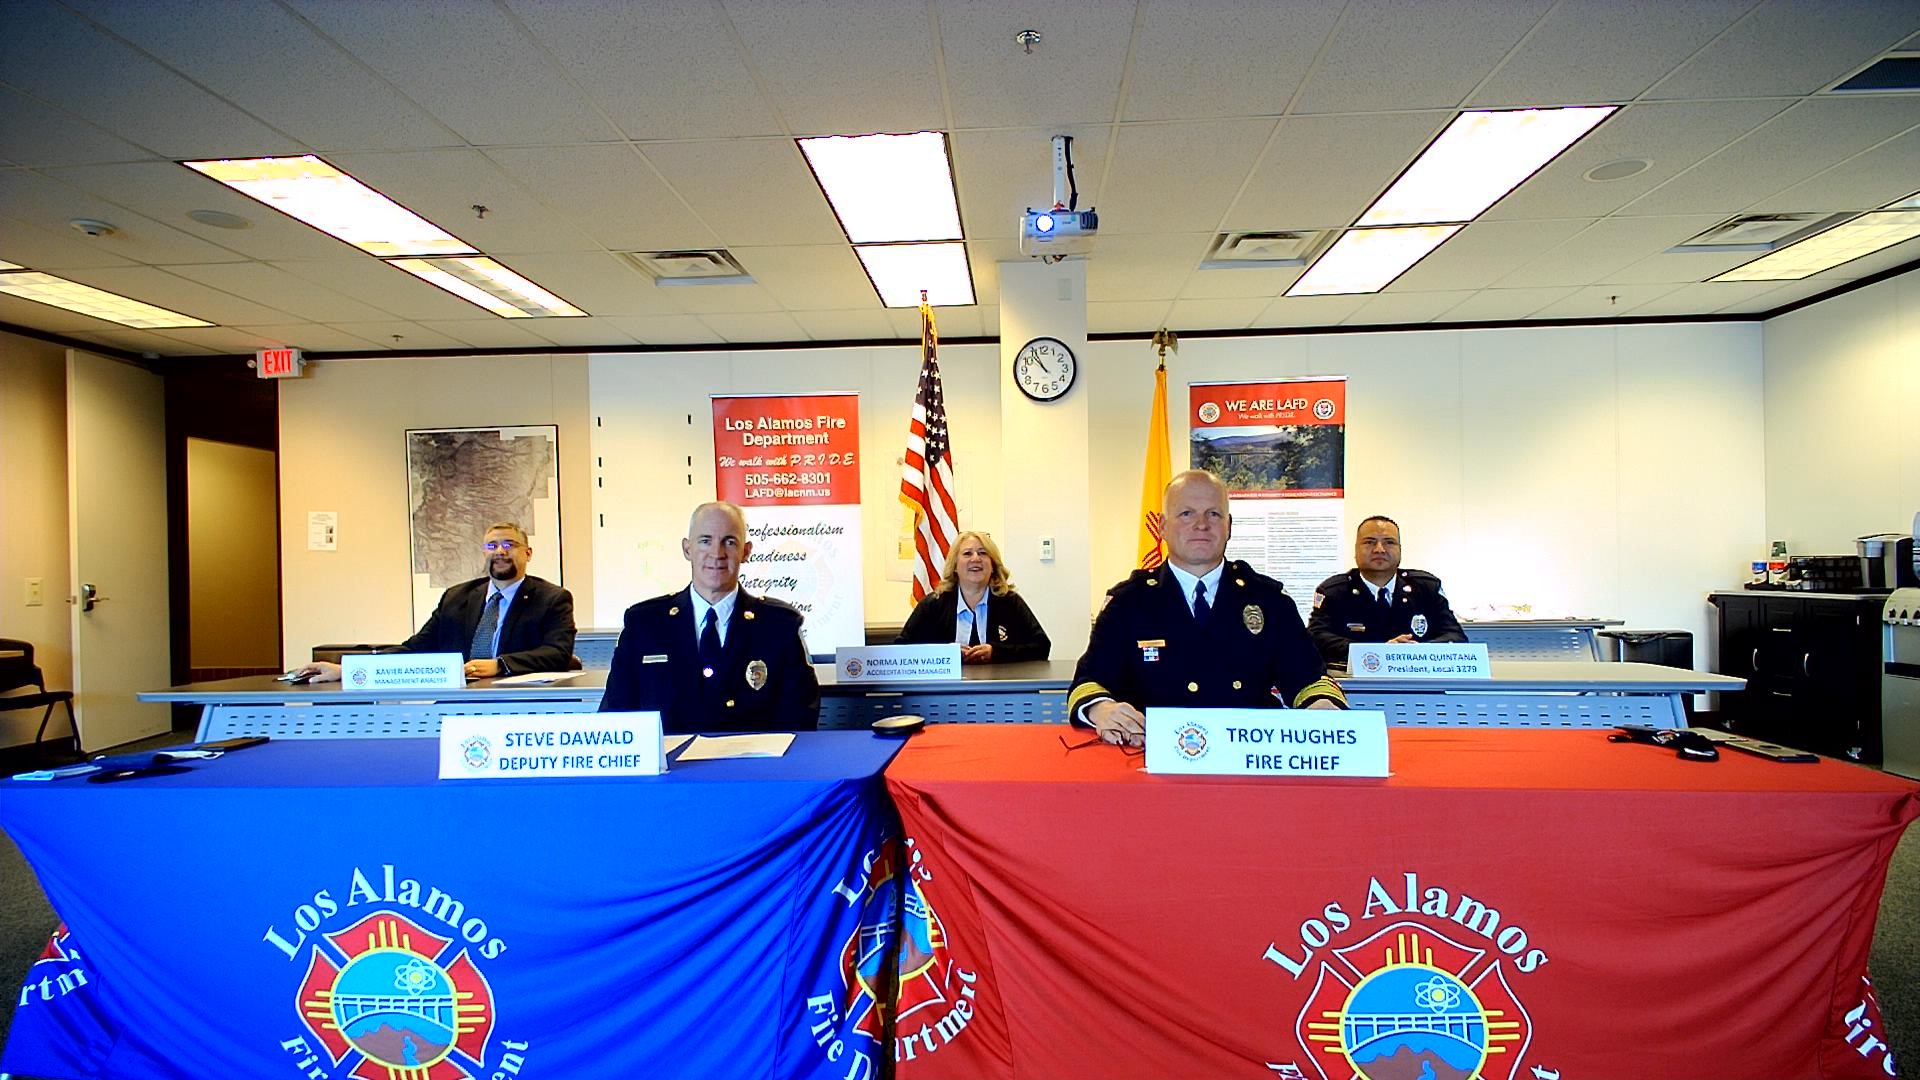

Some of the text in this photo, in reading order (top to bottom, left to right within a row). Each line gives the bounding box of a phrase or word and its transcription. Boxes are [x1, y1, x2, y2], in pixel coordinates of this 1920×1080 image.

[264, 350, 292, 374] EXIT
[1062, 363, 1068, 373] 3
[1021, 365, 1028, 375] 9
[1024, 375, 1031, 385] 8
[1051, 381, 1058, 390] 5
[1033, 382, 1040, 392] 7
[1041, 384, 1049, 393] 6
[1225, 400, 1247, 412] WE
[1249, 399, 1274, 411] ARE
[1277, 398, 1308, 410] LAFD
[725, 416, 846, 431] Los Alamos Fire
[743, 432, 829, 448] Department
[719, 456, 736, 467] We
[738, 455, 763, 467] walk
[766, 454, 788, 466] with
[745, 472, 831, 485] 505-662-8301
[745, 487, 831, 499] LAFD@lacnm.us
[741, 549, 807, 563] eadiness
[867, 657, 951, 667] NORMA JEAN VALDEZ
[1386, 653, 1477, 661] BERTRAM QUINTANA
[404, 667, 446, 675] ANDERSON
[1388, 665, 1430, 673] President,
[1433, 665, 1454, 673] Local
[506, 732, 554, 747] STEVE
[560, 730, 634, 746] DAWALD
[1226, 728, 1275, 743] TROY
[1281, 729, 1357, 744] HUGHES
[499, 755, 558, 771] DEPUTY
[562, 755, 593, 769] FIRE
[598, 754, 641, 768] CHIEF
[1246, 755, 1340, 770] FIRE CHIEF
[263, 864, 507, 961] Los Alamos
[1262, 871, 1548, 981] Los Alamos
